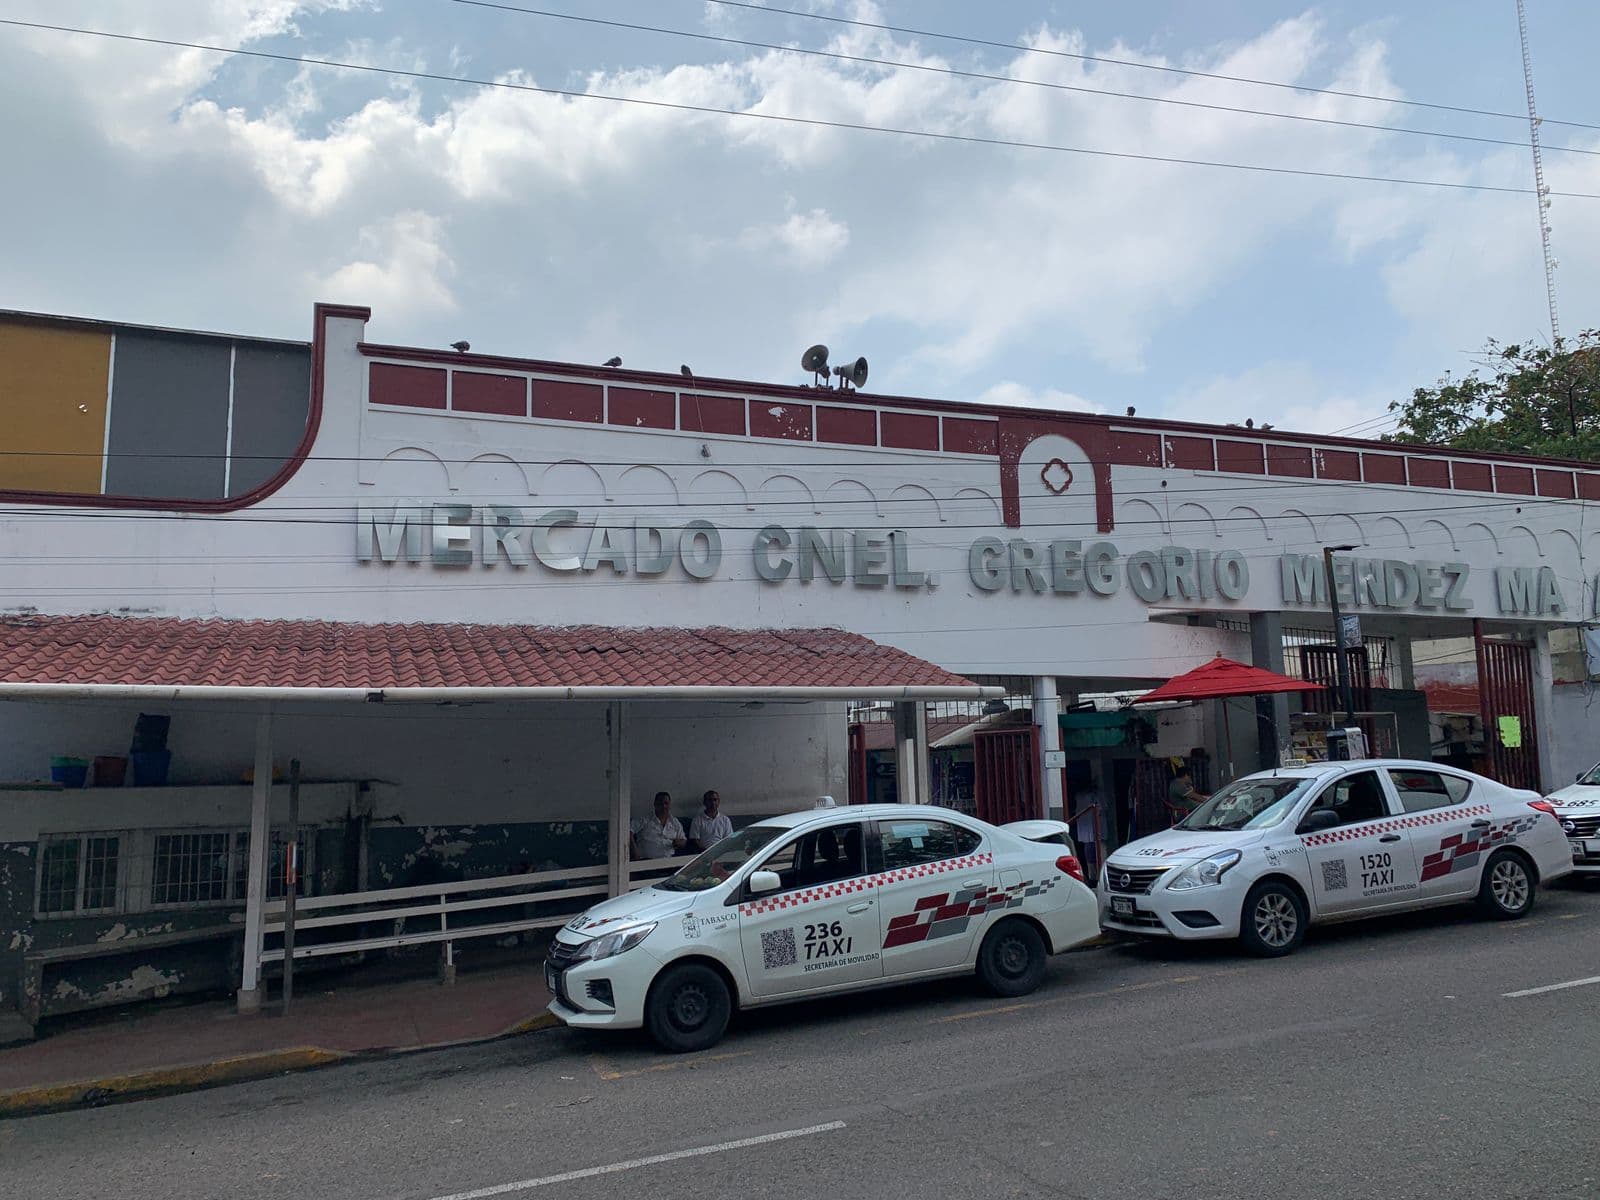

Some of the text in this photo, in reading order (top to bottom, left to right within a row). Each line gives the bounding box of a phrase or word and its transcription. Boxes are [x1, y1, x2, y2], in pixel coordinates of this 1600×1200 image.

[357, 498, 723, 580] MERCADO
[753, 524, 940, 589] CNEL.
[968, 535, 1250, 603] GREGORIO
[1280, 553, 1474, 609] MENDEZ
[1360, 852, 1392, 870] 1520
[1361, 869, 1394, 888] TAXI
[700, 912, 737, 926] TABASCO
[804, 920, 843, 941] 236
[804, 937, 852, 960] TAXI
[839, 957, 847, 967] DE
[847, 952, 880, 965] MOVILIDAD
